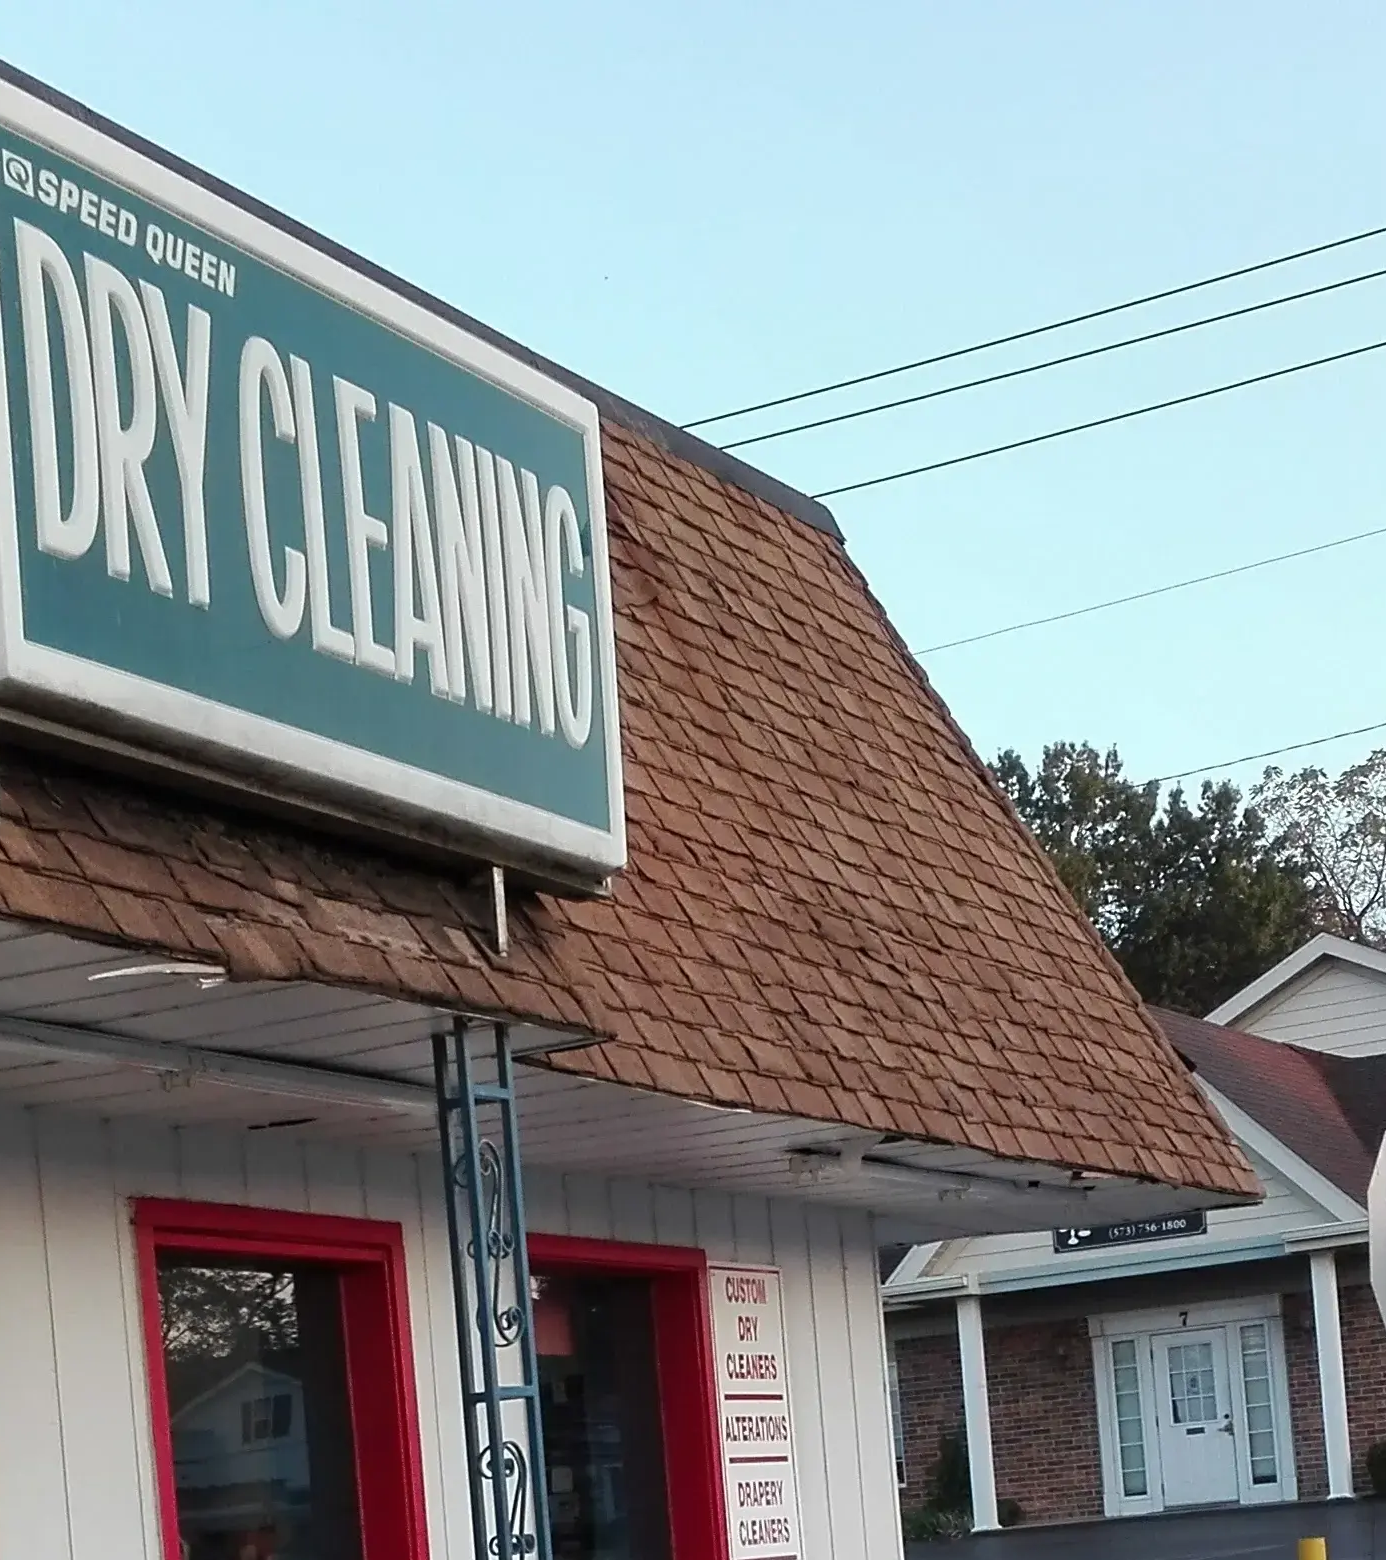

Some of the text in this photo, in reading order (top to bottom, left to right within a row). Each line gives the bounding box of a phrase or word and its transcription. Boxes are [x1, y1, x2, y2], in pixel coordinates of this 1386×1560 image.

[37, 169, 138, 247] SPEED
[145, 224, 236, 298] QUEEN
[13, 216, 593, 750] DRY CLEANING
[1109, 1225, 1135, 1239] (573)
[725, 1276, 766, 1304] CUSTOM
[738, 1316, 758, 1341] DRY
[1179, 1311, 1189, 1326] 7
[726, 1353, 778, 1380] CLEANERS
[725, 1415, 788, 1441] ALTERATIONS
[738, 1480, 783, 1507] DRAPERY
[739, 1518, 790, 1546] CLEANERS
